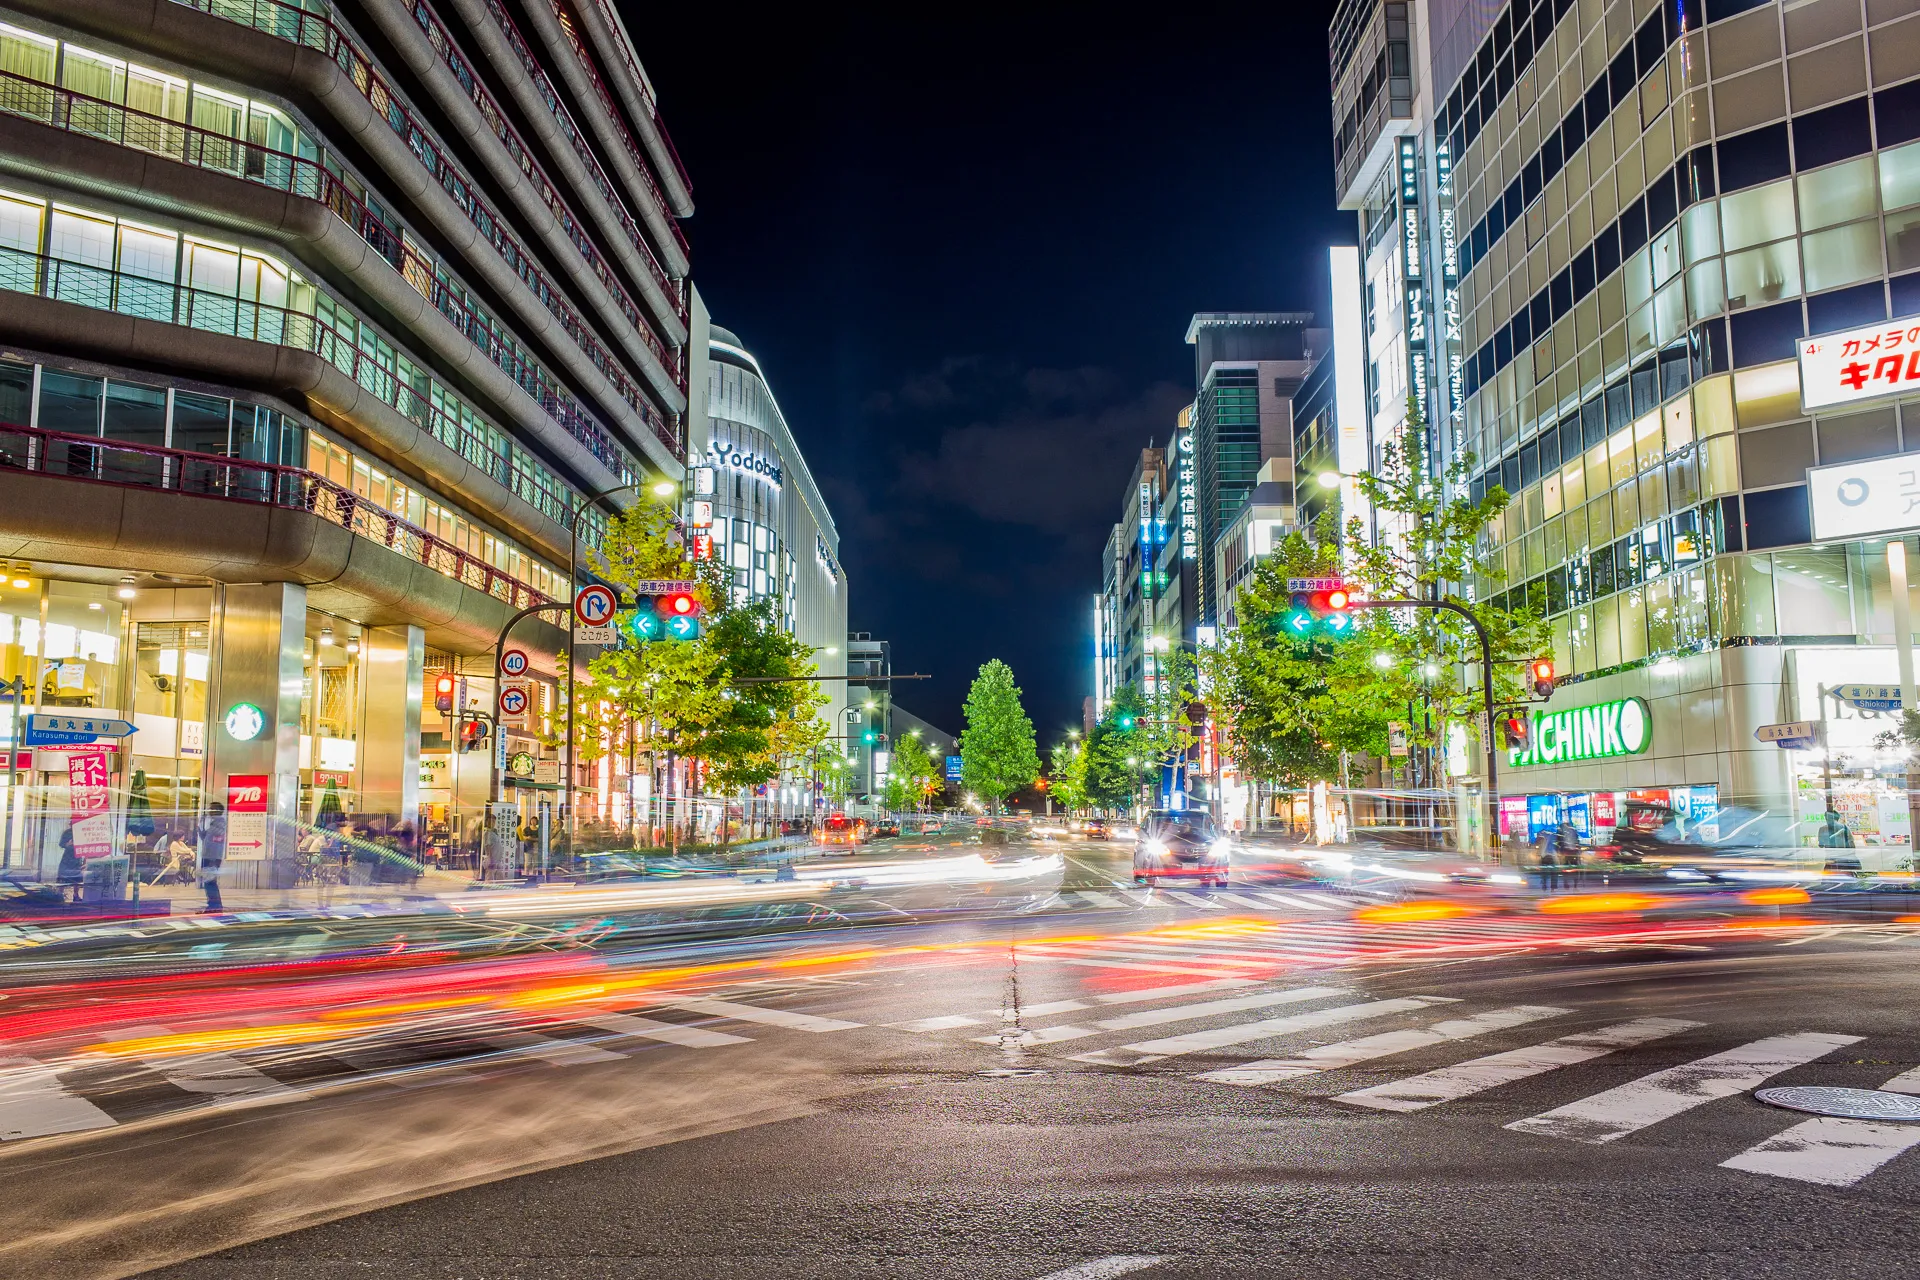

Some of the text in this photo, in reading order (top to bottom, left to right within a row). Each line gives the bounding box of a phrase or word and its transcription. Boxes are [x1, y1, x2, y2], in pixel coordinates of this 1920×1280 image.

[1180, 469, 1197, 560] 中央信用金庫
[639, 581, 692, 592] 歩車分離信号
[1289, 579, 1343, 590] 歩車分離信号
[580, 631, 610, 641] ここから
[507, 657, 523, 669] 40
[1860, 700, 1890, 708] Shiokoji
[48, 718, 110, 732] 烏丸通り
[32, 731, 88, 741] Karasuma dori
[86, 756, 106, 809] ストップ
[234, 786, 262, 804] JTB
[509, 811, 517, 870] やめましょう
